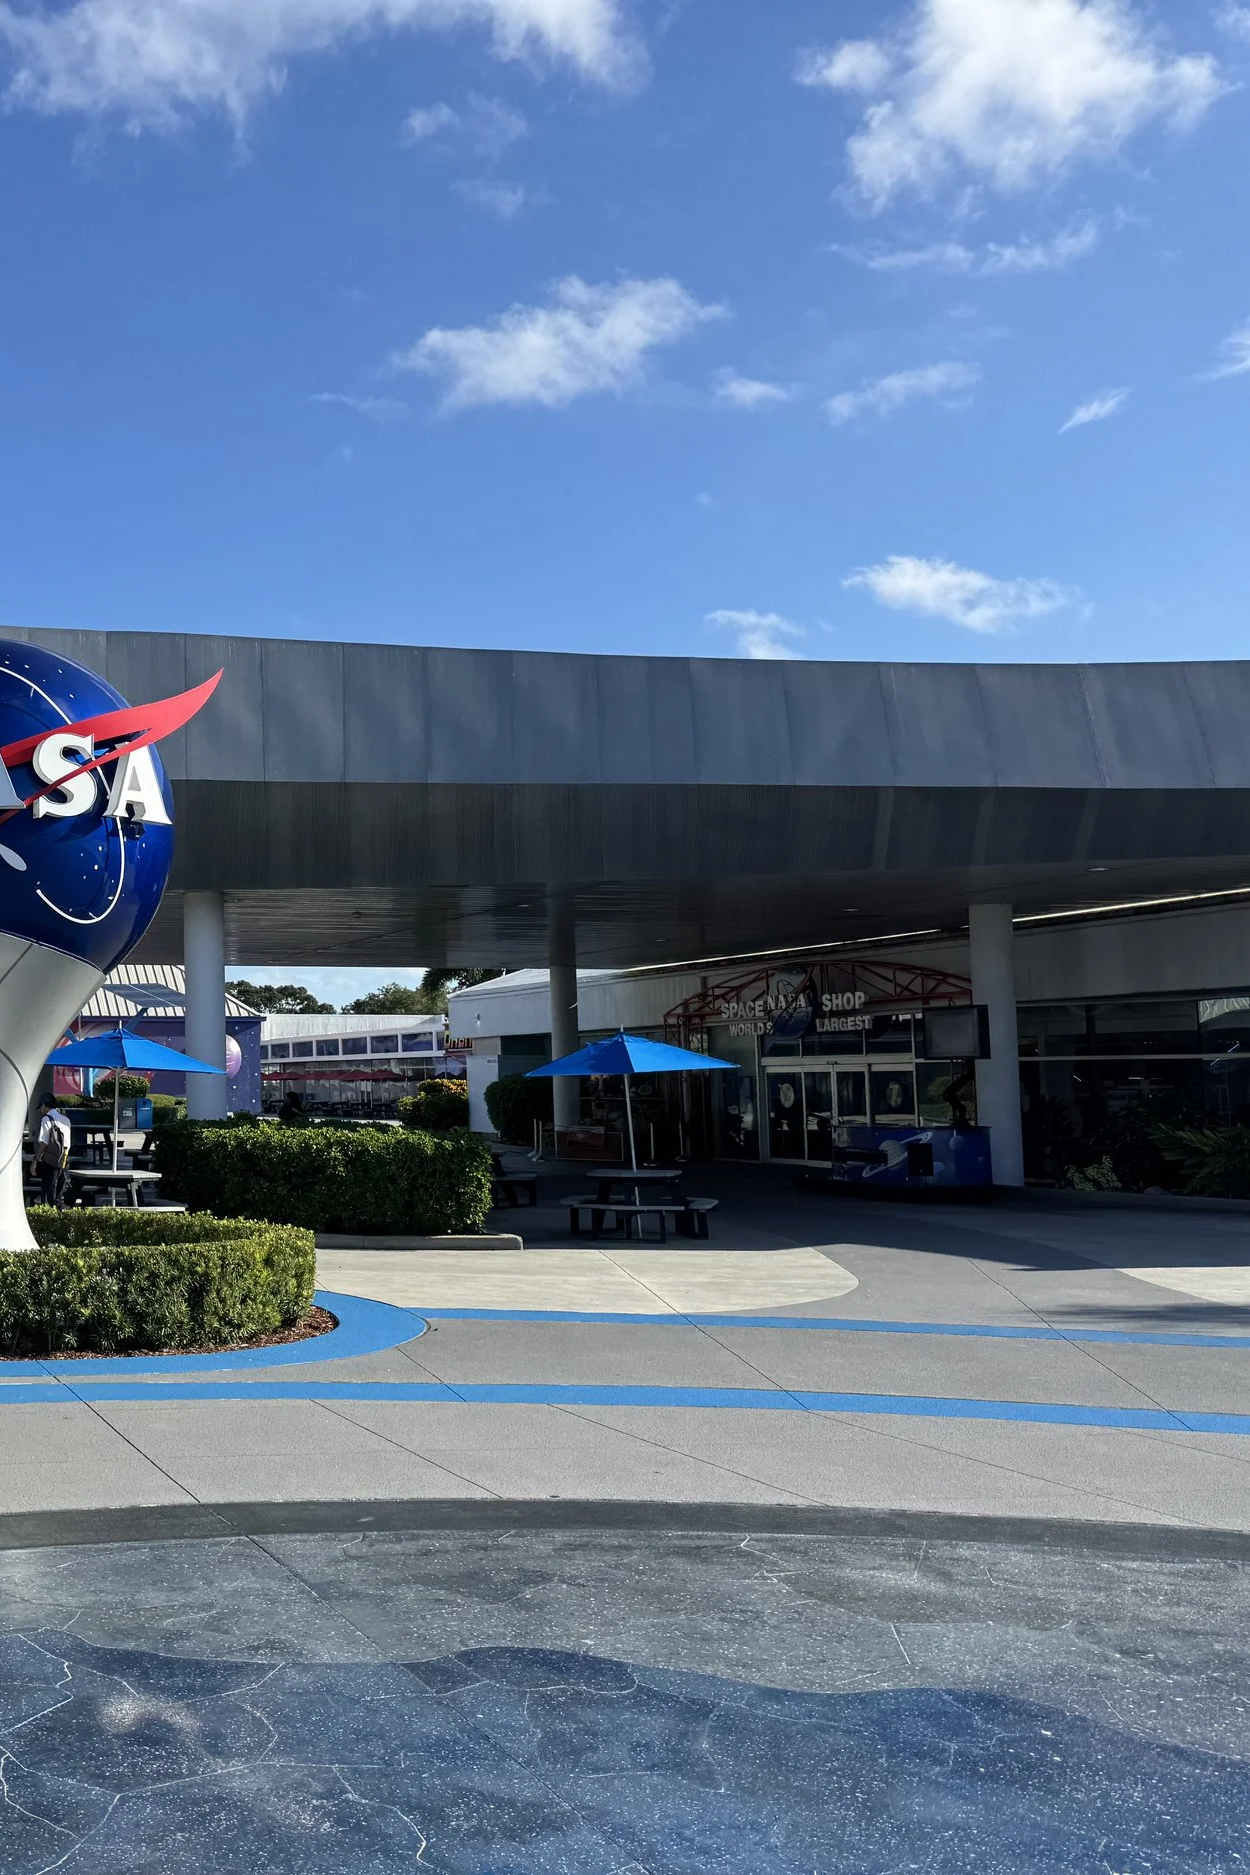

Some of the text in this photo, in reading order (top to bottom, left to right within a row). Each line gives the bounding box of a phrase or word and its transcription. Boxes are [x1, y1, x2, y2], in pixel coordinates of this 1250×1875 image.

[721, 991, 866, 1019] SPACE SHOP
[816, 1015, 873, 1032] LARGEST
